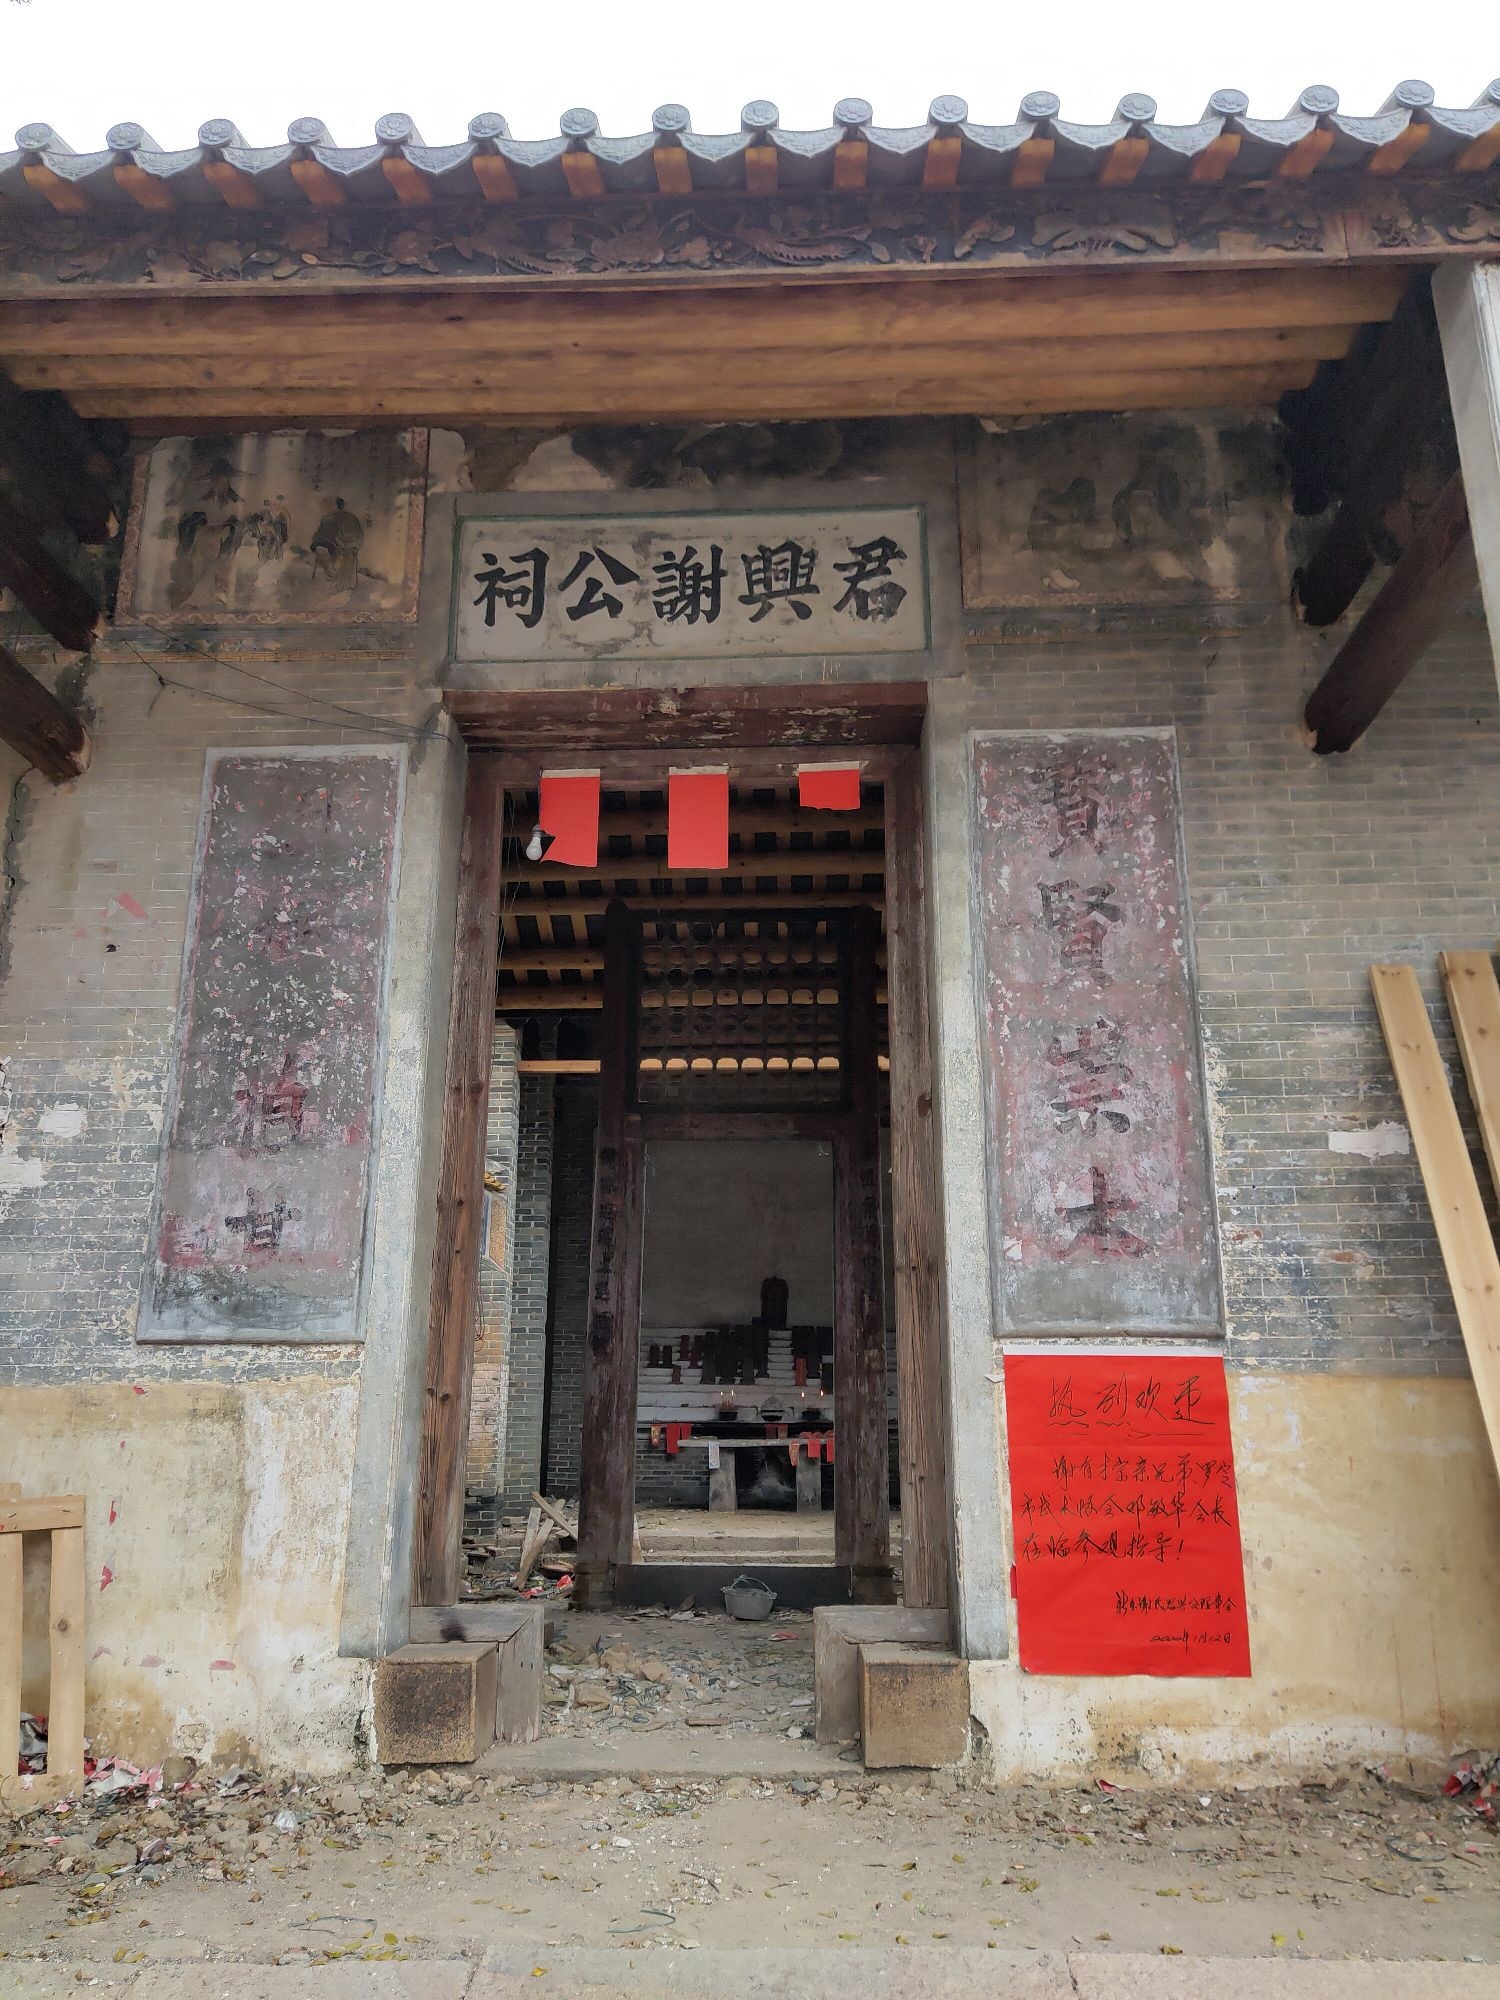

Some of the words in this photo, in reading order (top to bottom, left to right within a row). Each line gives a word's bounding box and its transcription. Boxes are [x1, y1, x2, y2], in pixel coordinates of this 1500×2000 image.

[473, 536, 908, 628] 君興謝公祠
[1046, 1372, 1216, 1428] 热烈欢迎
